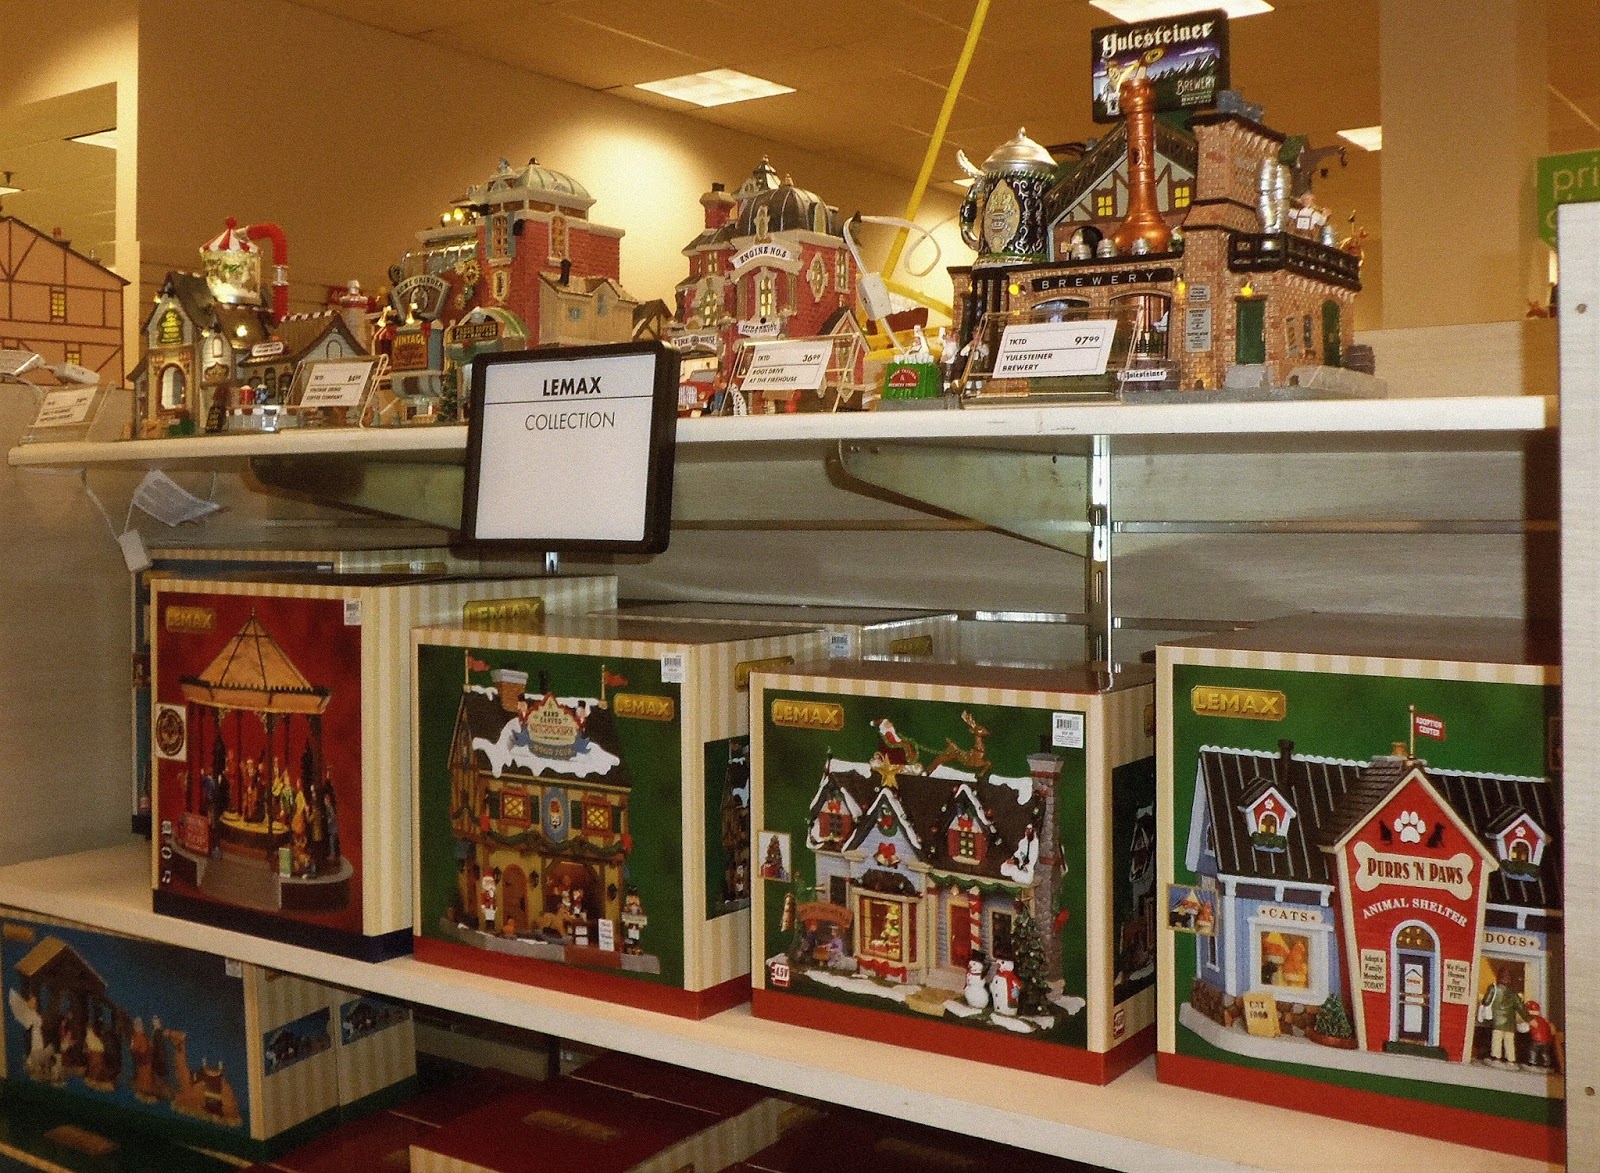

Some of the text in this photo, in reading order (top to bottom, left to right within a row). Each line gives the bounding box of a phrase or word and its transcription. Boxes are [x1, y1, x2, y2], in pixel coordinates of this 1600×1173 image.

[1100, 20, 1215, 59] Yulesteiner
[1176, 75, 1217, 95] BREWERY
[739, 246, 768, 264] ENGINE
[1041, 272, 1153, 290] BREWERY
[1009, 338, 1027, 346] TKTD
[1005, 353, 1053, 362] YULESTEINER
[1002, 363, 1039, 372] BREWERY
[543, 376, 602, 397] LEMAX
[525, 412, 615, 431] COLLECTION
[616, 698, 669, 717] LEMAX
[1194, 691, 1280, 715] LEMAX
[774, 703, 839, 725] LEMAX
[1367, 857, 1410, 880] PURRS
[1429, 863, 1464, 885] PAWS
[1362, 898, 1468, 928] ANIMAL SHELTER
